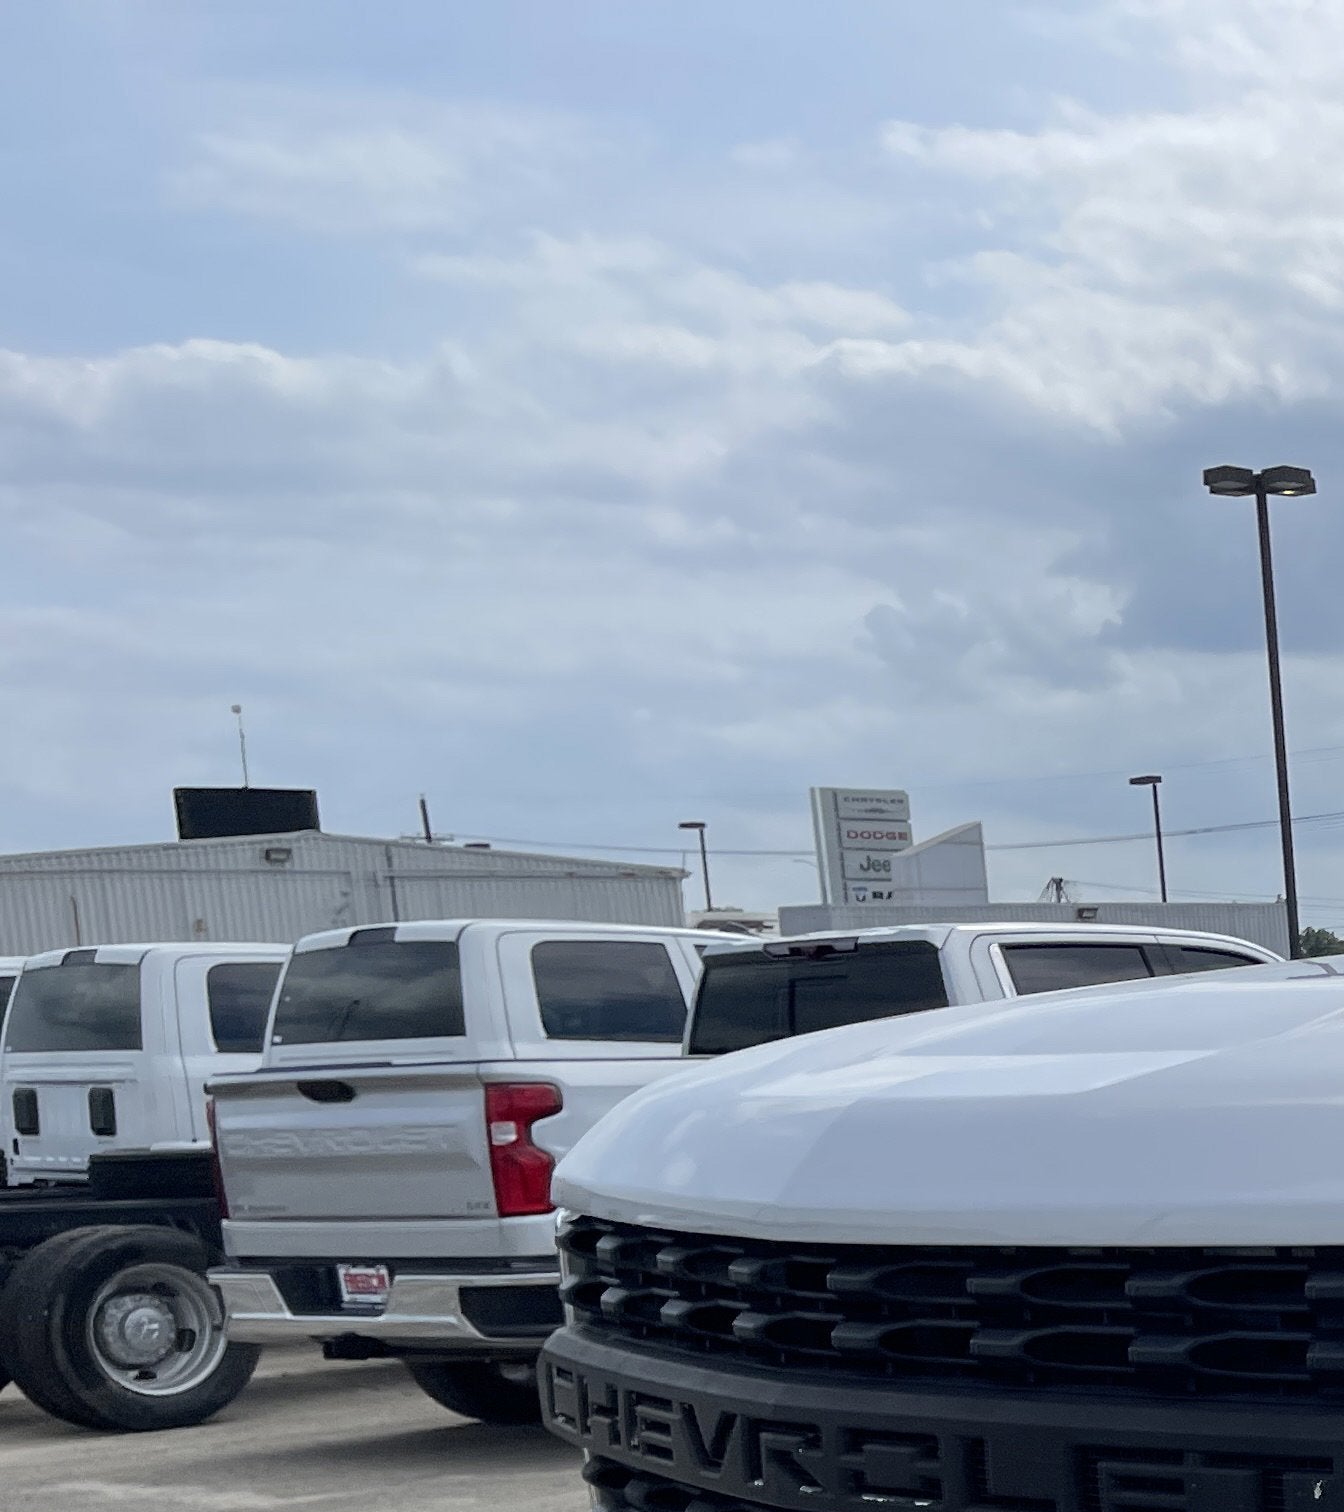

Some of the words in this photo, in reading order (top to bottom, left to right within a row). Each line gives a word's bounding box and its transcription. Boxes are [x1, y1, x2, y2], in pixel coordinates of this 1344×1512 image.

[843, 796, 904, 805] CHRYSLER
[846, 829, 908, 841] DODGE
[859, 855, 892, 872] Jee
